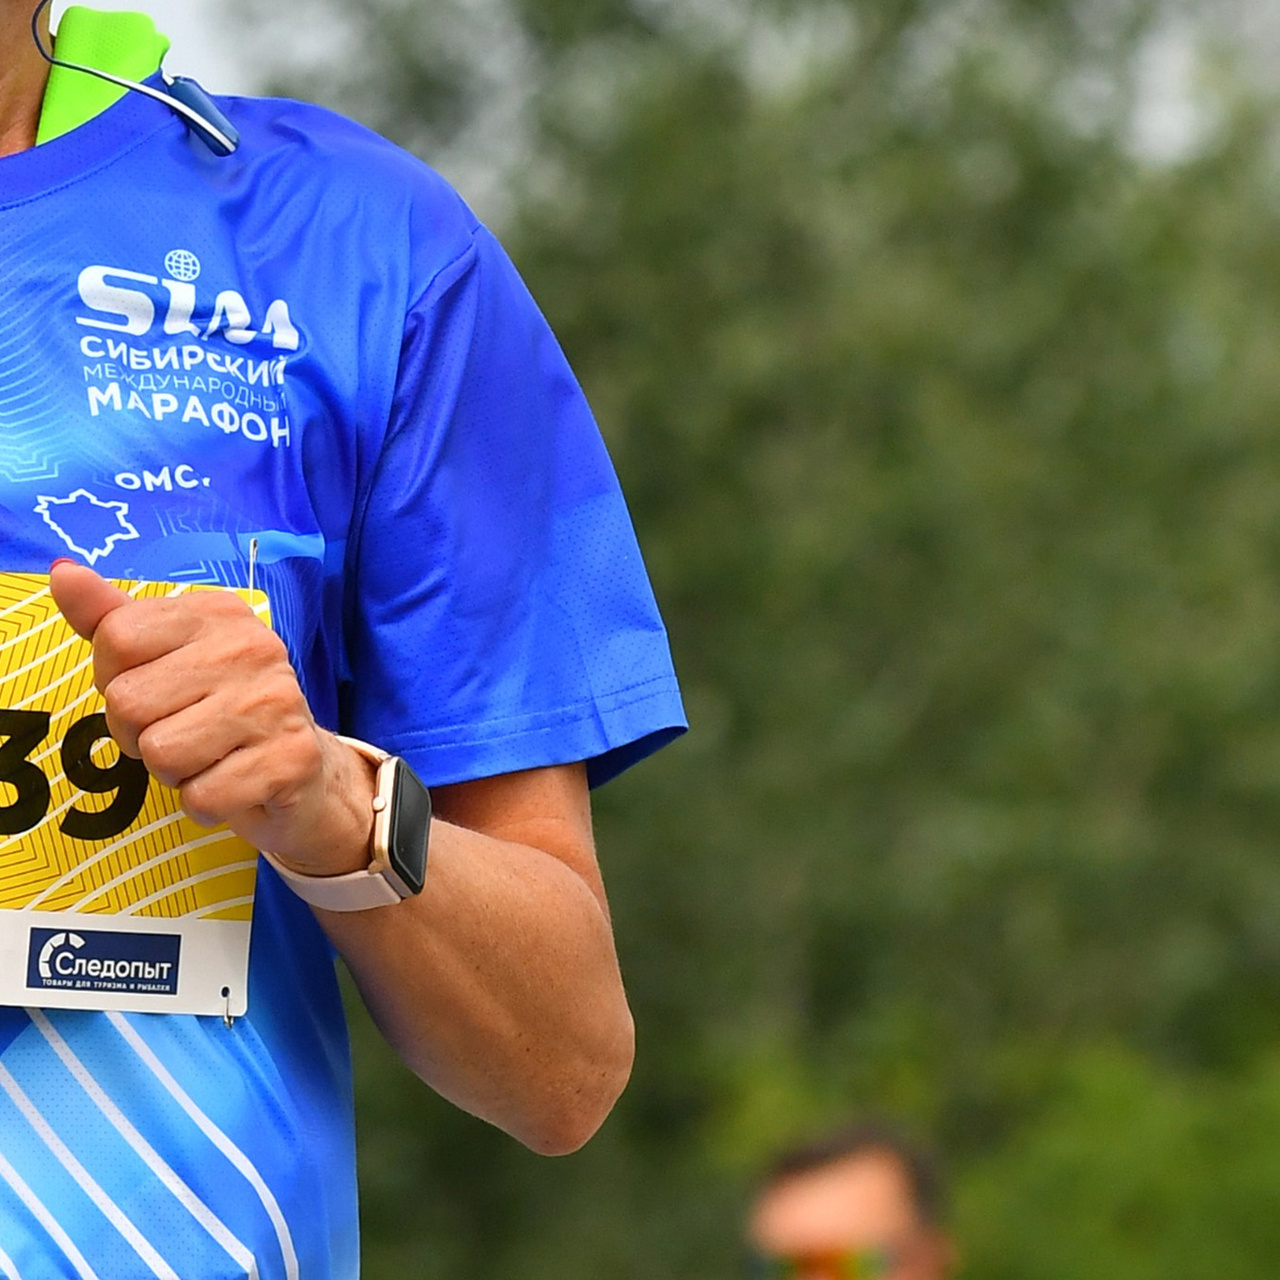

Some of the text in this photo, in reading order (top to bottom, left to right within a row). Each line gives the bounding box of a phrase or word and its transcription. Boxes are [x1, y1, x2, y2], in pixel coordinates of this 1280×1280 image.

[80, 335, 288, 388] СИБИРСКИЙ
[87, 382, 291, 448] МАРАФОН
[114, 464, 211, 491] ОМС
[55, 951, 172, 979] Следопыт
